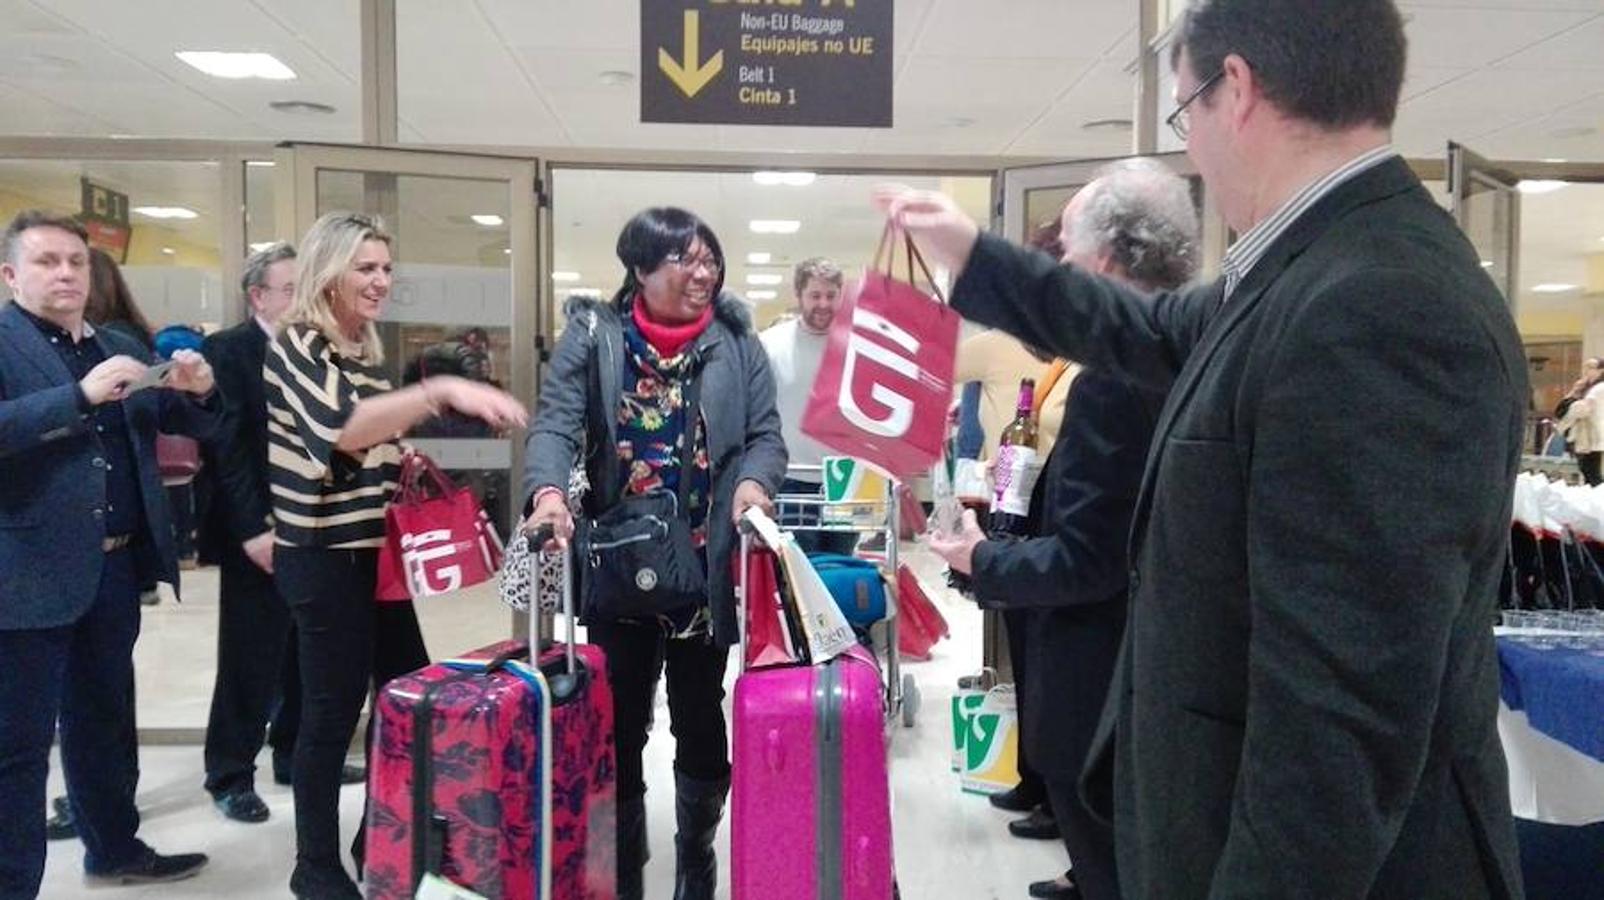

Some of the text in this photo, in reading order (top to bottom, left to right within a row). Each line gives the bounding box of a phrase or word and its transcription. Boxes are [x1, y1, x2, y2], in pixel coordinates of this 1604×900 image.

[740, 12, 844, 34] Non-EU Baggage
[740, 34, 874, 55] Equipajes no UE
[739, 66, 775, 84] Belt 1
[739, 87, 797, 105] Cinta 1
